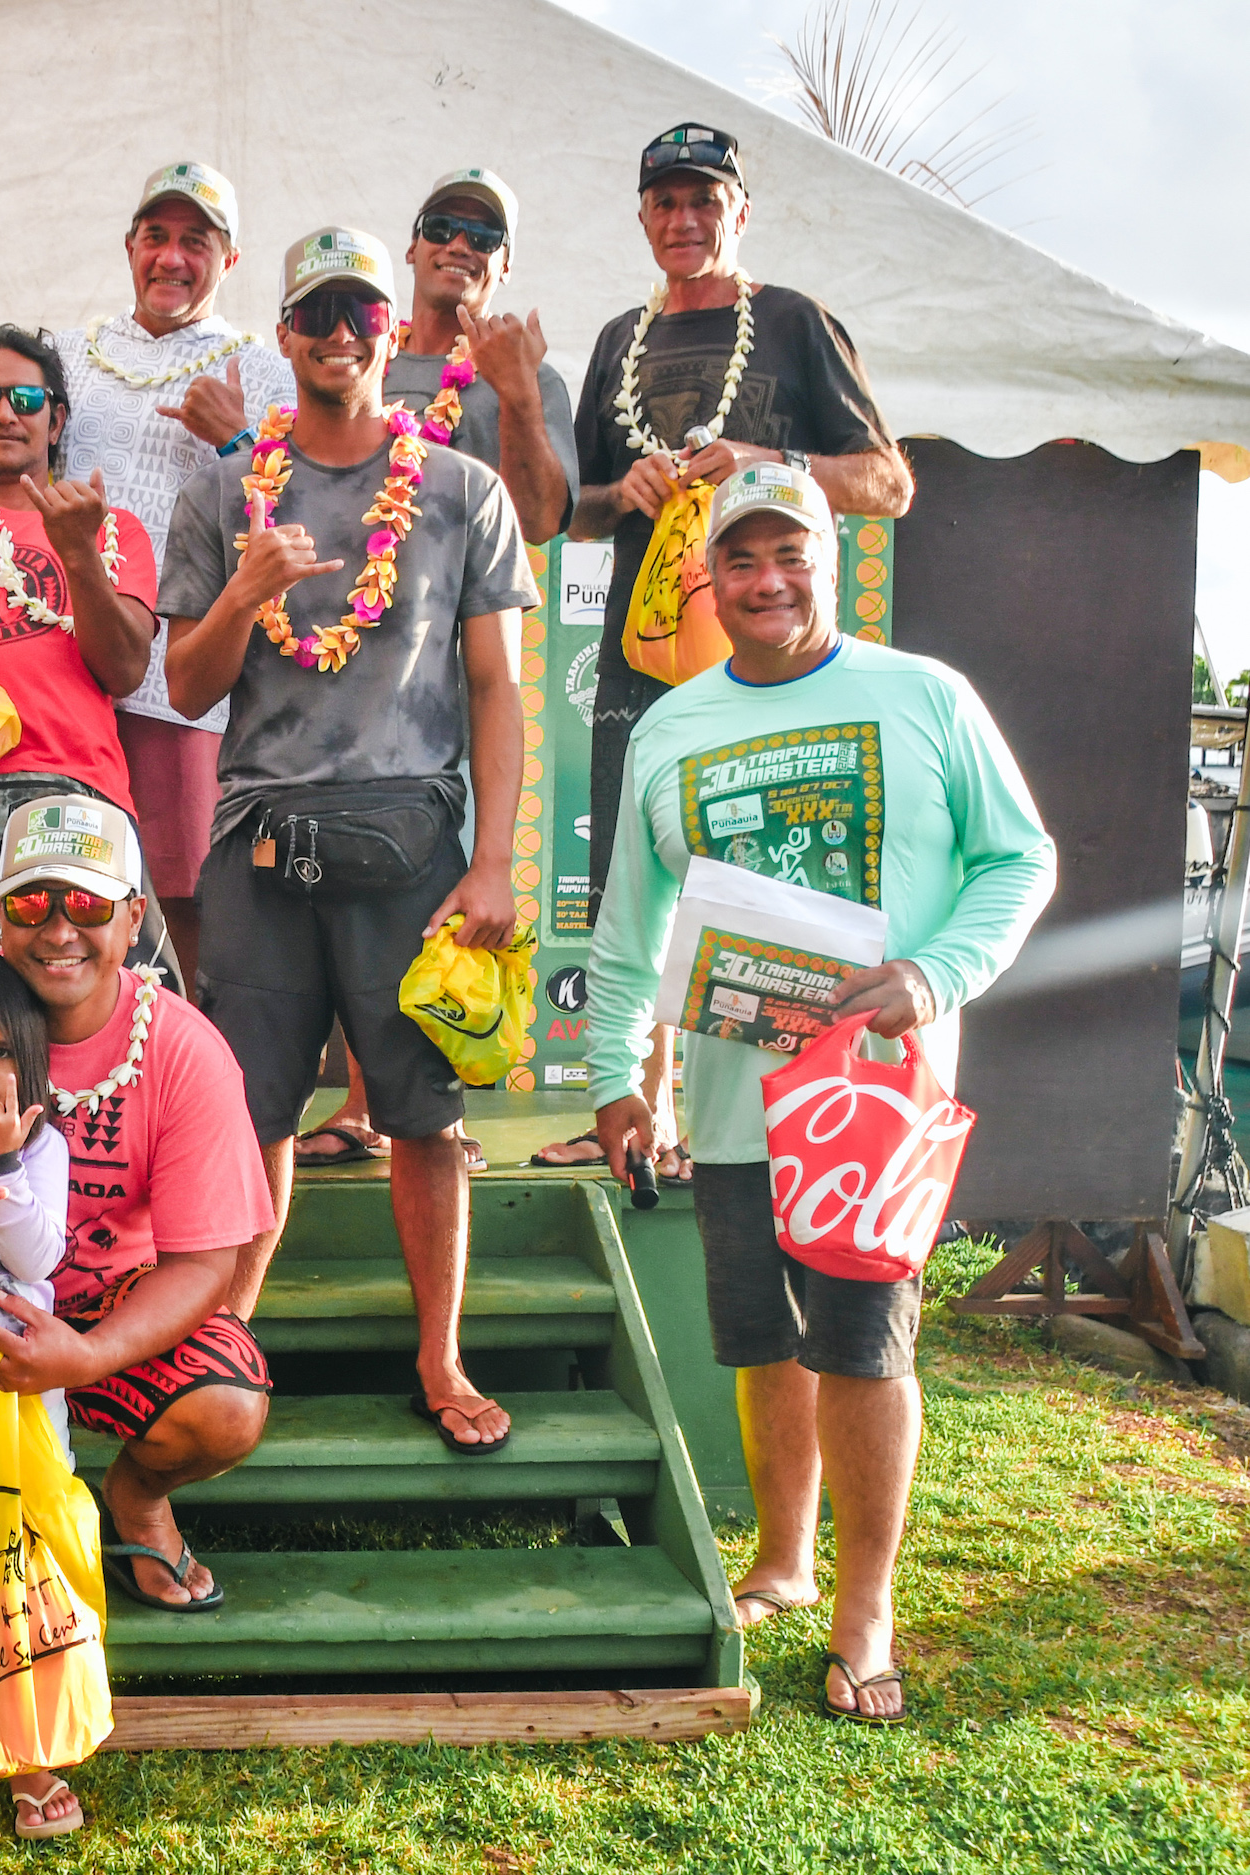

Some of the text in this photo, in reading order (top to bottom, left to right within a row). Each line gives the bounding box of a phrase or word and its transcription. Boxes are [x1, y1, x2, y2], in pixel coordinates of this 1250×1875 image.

[565, 641, 600, 694] TAAPUNA
[748, 742, 840, 768] TAAPUNA
[744, 757, 837, 784] MASTER
[822, 780, 852, 790] OCT
[711, 813, 759, 830] Punaauia
[786, 799, 836, 825] XXX
[66, 817, 99, 829] Punaauia
[43, 831, 102, 848] TAAPUNA
[40, 842, 101, 859] MASTER
[757, 961, 836, 990] TAAPUNA
[750, 972, 830, 1002] MASTER
[713, 999, 752, 1016] Punaauia
